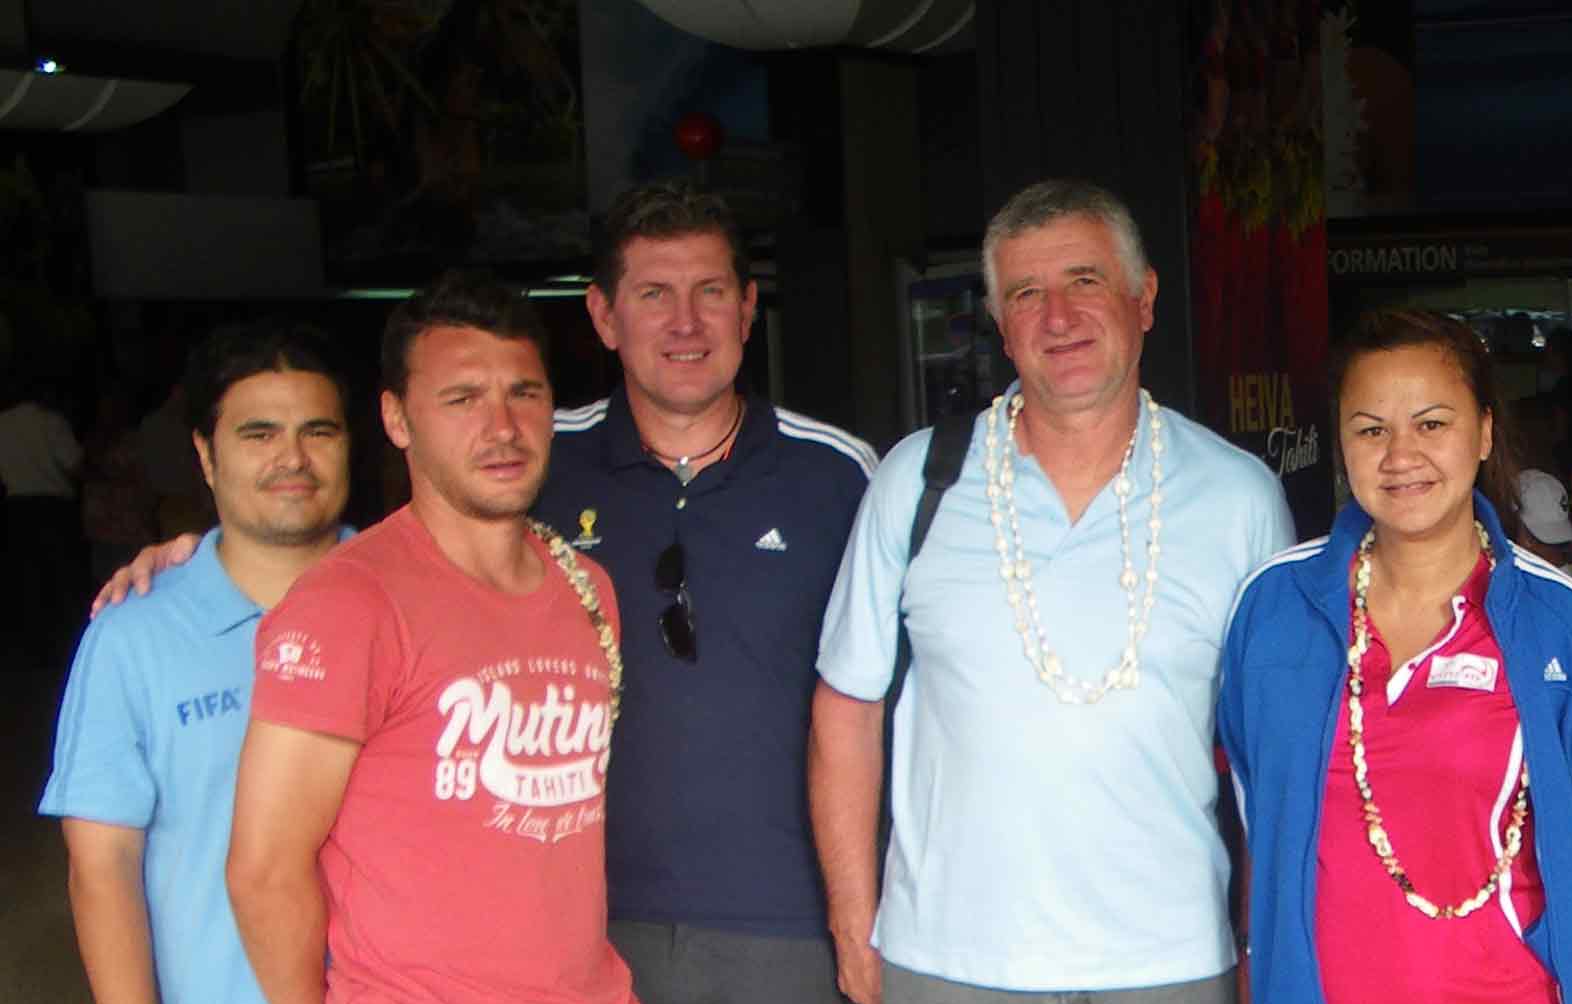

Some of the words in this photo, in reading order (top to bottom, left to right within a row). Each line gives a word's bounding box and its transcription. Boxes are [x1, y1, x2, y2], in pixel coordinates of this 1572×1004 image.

[1229, 372, 1295, 433] HEIVA
[1267, 423, 1320, 477] Tahiti
[176, 688, 242, 727] FIFA
[435, 759, 477, 800] 89
[514, 770, 588, 801] TAHITI
